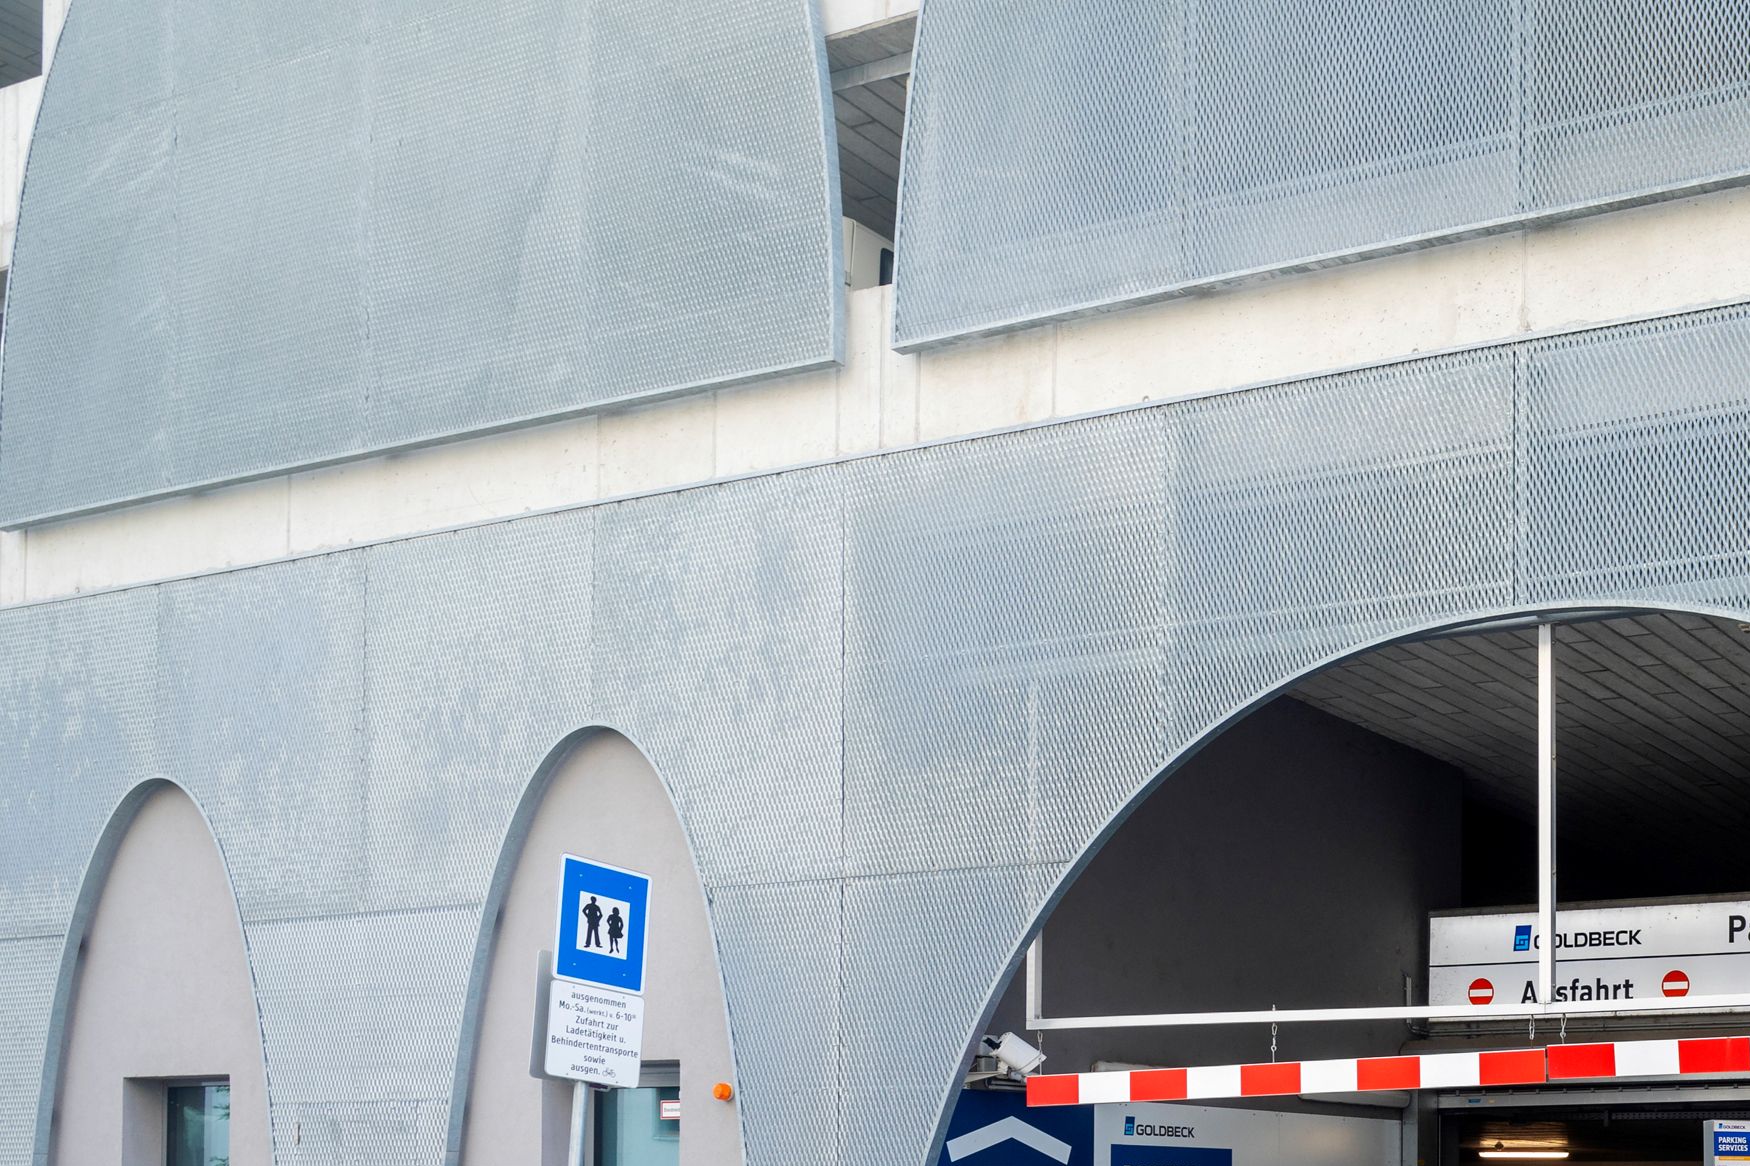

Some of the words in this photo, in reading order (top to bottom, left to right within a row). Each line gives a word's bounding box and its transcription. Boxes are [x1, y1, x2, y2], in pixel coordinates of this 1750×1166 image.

[1521, 977, 1634, 1004] Asfahrt
[559, 1000, 586, 1013] Mo.-Sa.
[571, 991, 627, 1009] ausgenommen
[576, 1015, 604, 1029] Zufahrt
[606, 1023, 619, 1031] zur
[566, 1025, 617, 1042] Ladetätigkeit
[551, 1035, 639, 1059] Behindertentransporte
[584, 1055, 606, 1065] sowie
[571, 1063, 601, 1075] ausgen.
[1135, 1124, 1195, 1138] GOLDBECK
[1718, 1136, 1747, 1144] PARKING
[1718, 1144, 1749, 1152] SERVICES
